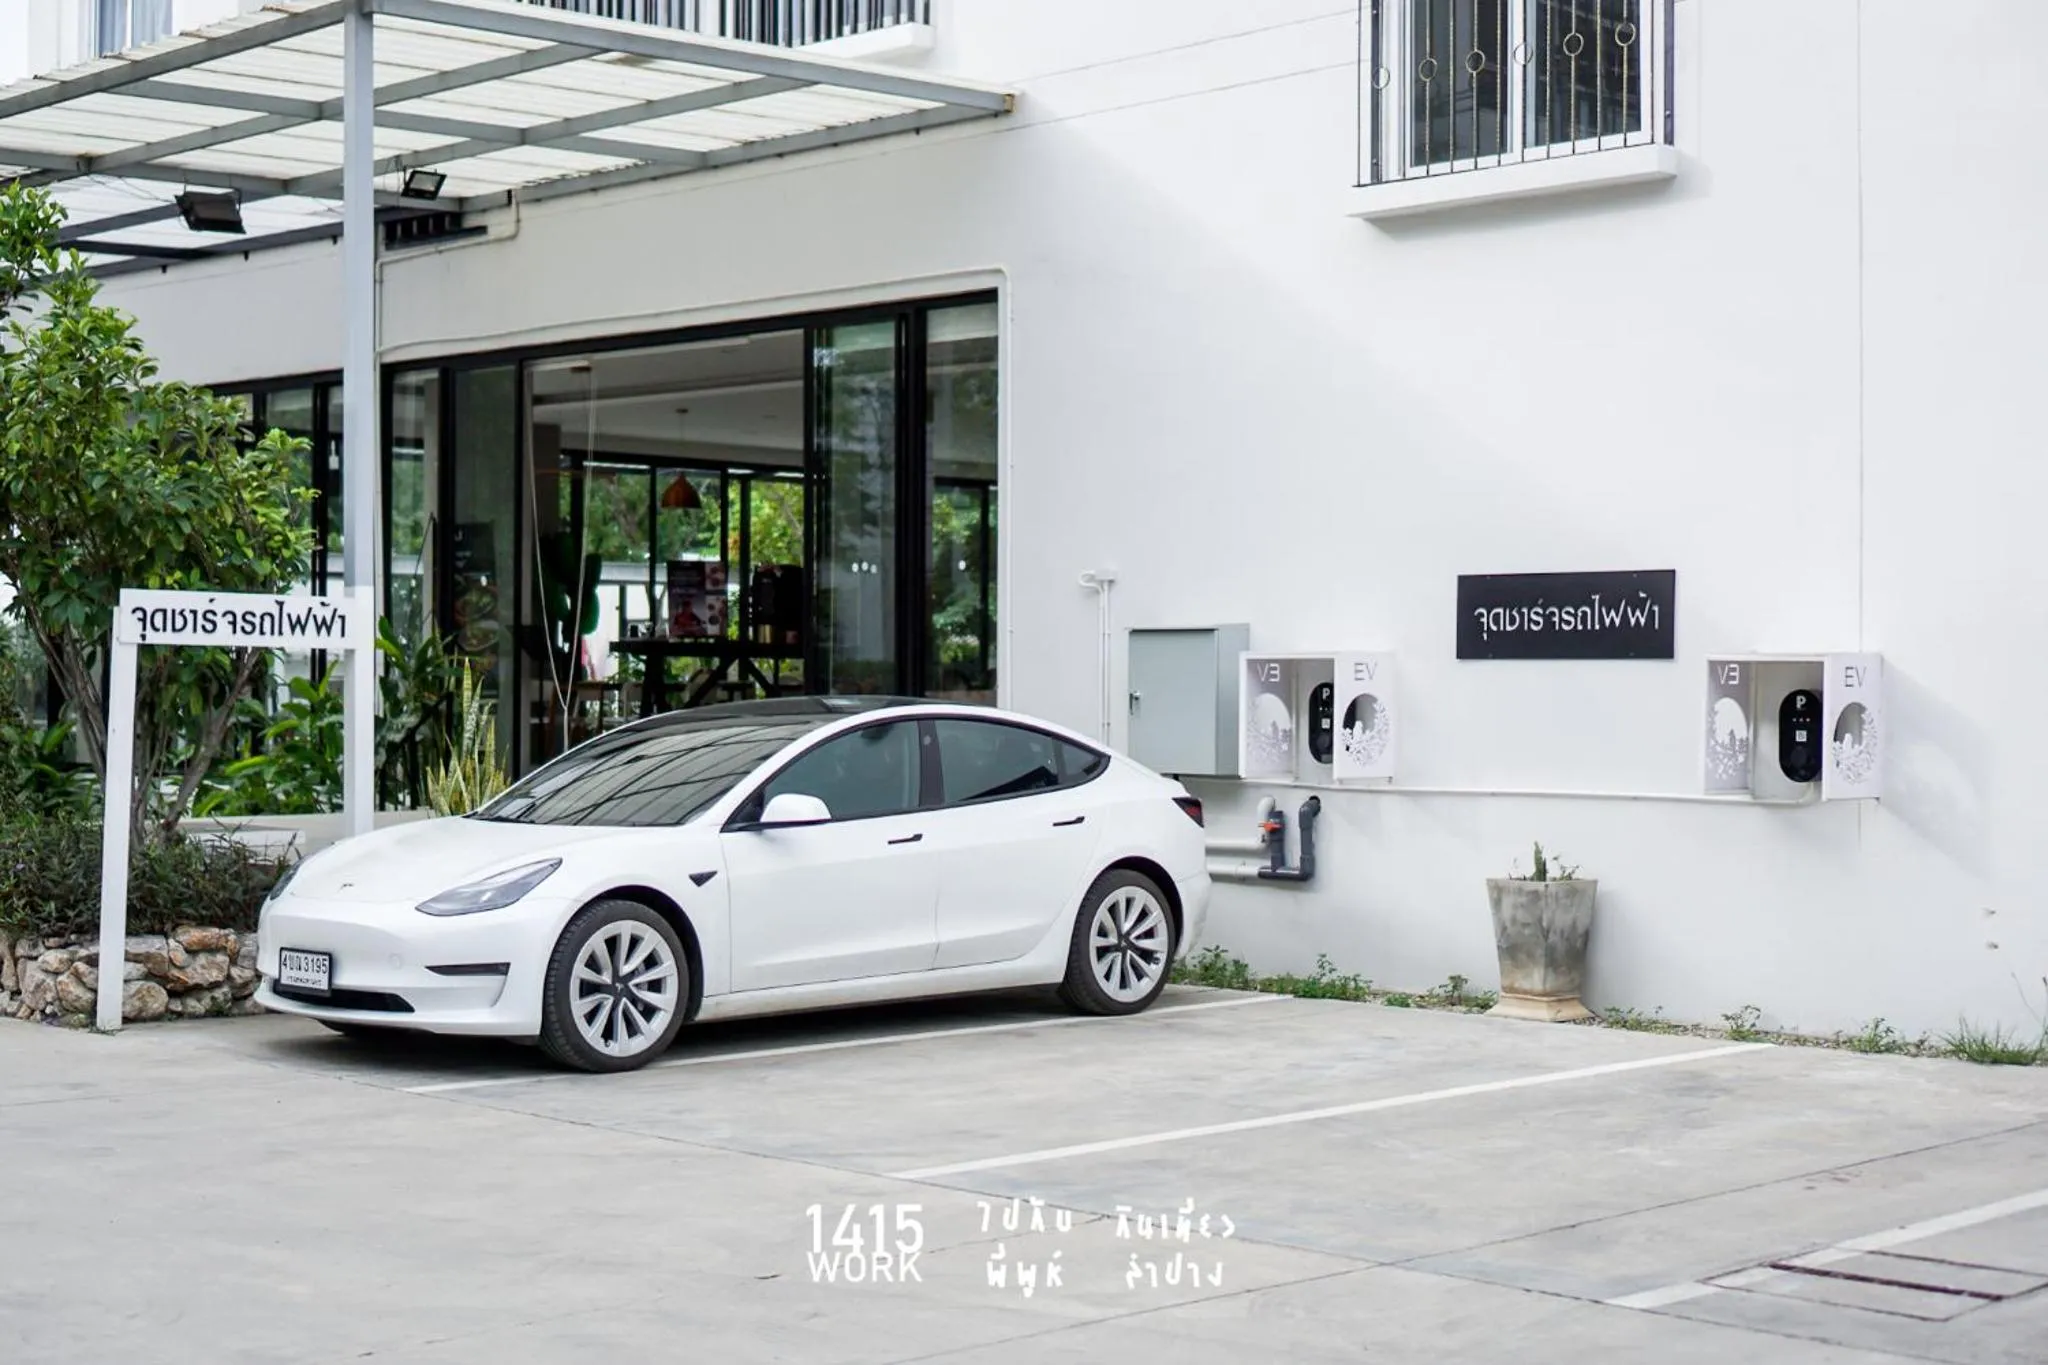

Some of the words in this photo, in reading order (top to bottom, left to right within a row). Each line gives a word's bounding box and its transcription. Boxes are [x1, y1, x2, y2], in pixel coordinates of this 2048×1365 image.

[131, 598, 346, 641] จุดชาร์จรถไฟฟ้า
[1474, 592, 1659, 641] จุดชาร์จรถไฟฟ้า
[1354, 661, 1377, 681] EV
[1844, 666, 1867, 688] EV
[304, 956, 328, 974] 3195
